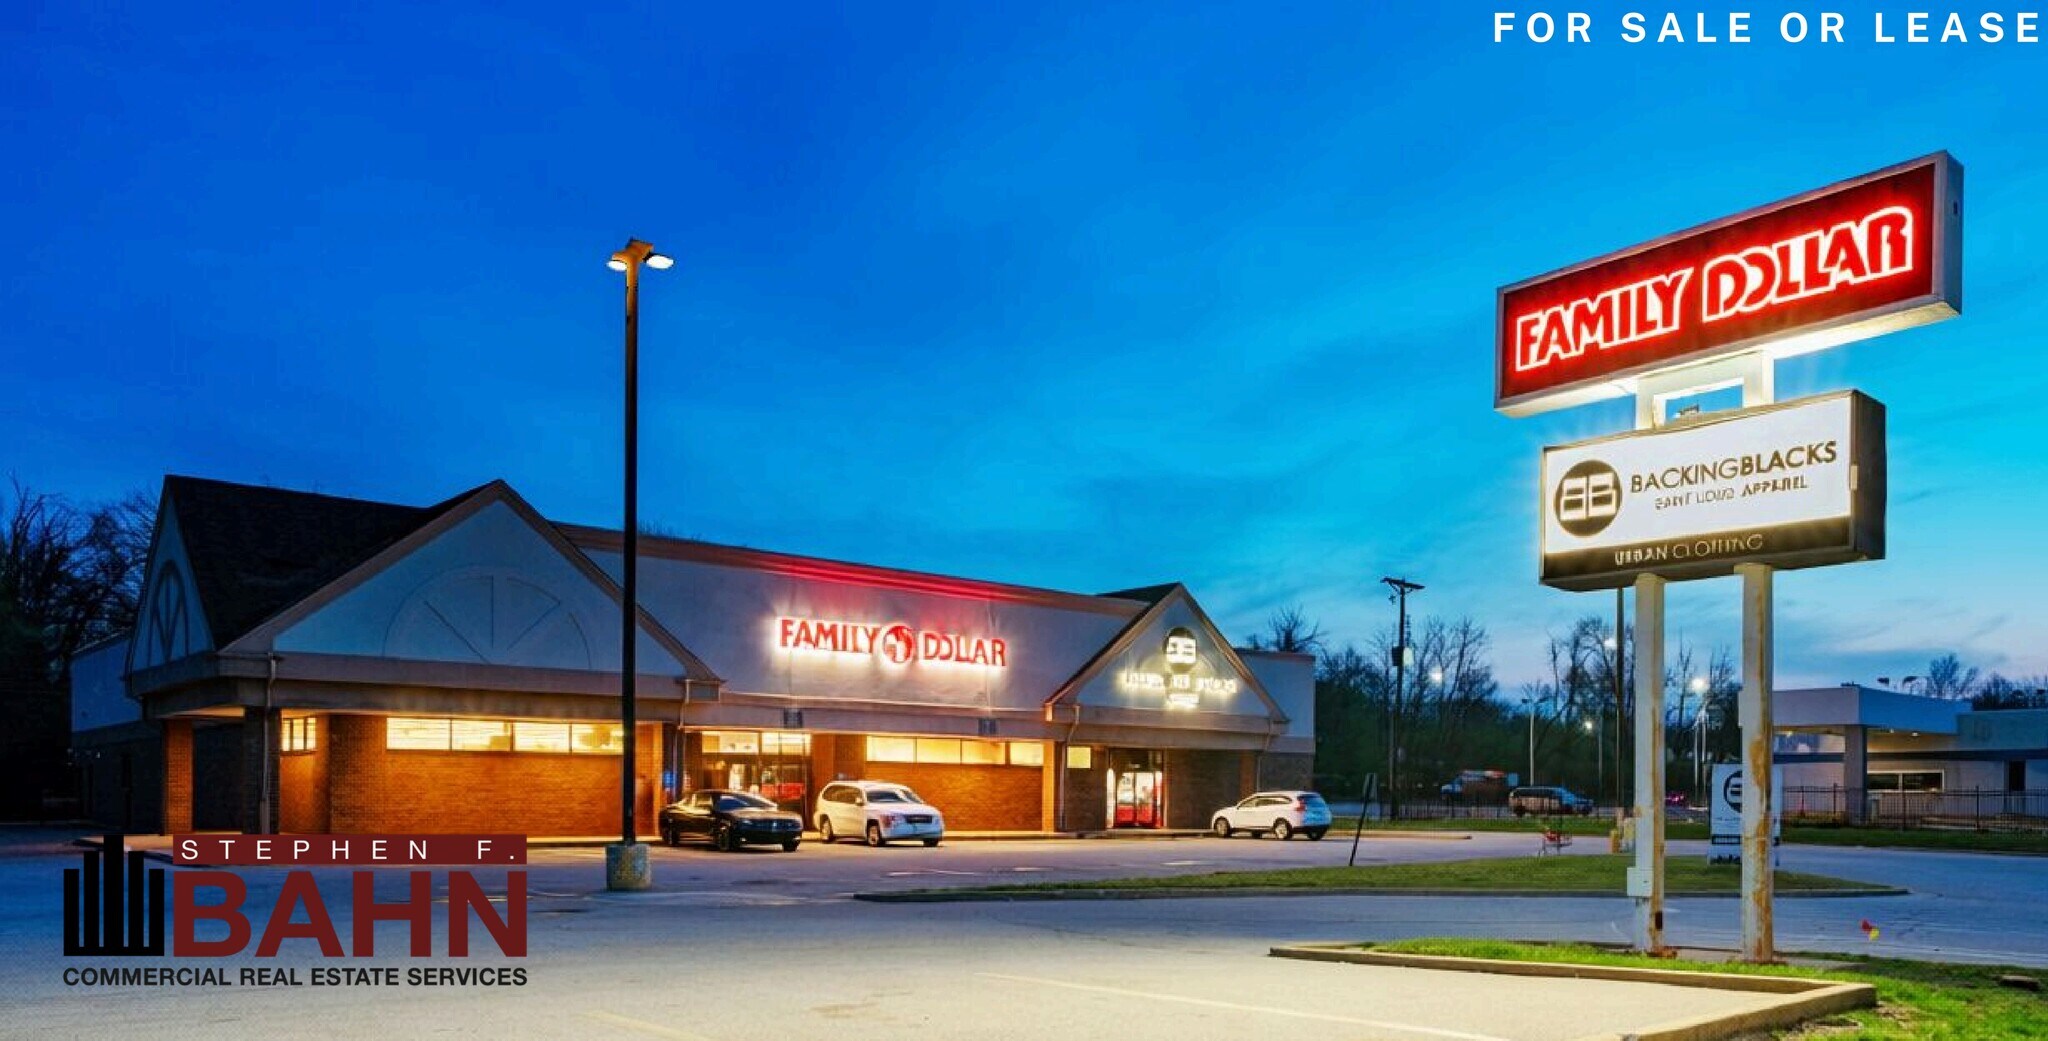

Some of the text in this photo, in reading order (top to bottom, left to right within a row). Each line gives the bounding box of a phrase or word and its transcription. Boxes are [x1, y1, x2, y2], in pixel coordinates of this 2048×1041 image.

[1516, 205, 1914, 372] FAMILY DOLLAR
[1630, 440, 1837, 493] BACKINGBLACKS
[1615, 545, 1668, 566] URBAN
[779, 618, 1007, 667] FAMILY DOLLAR
